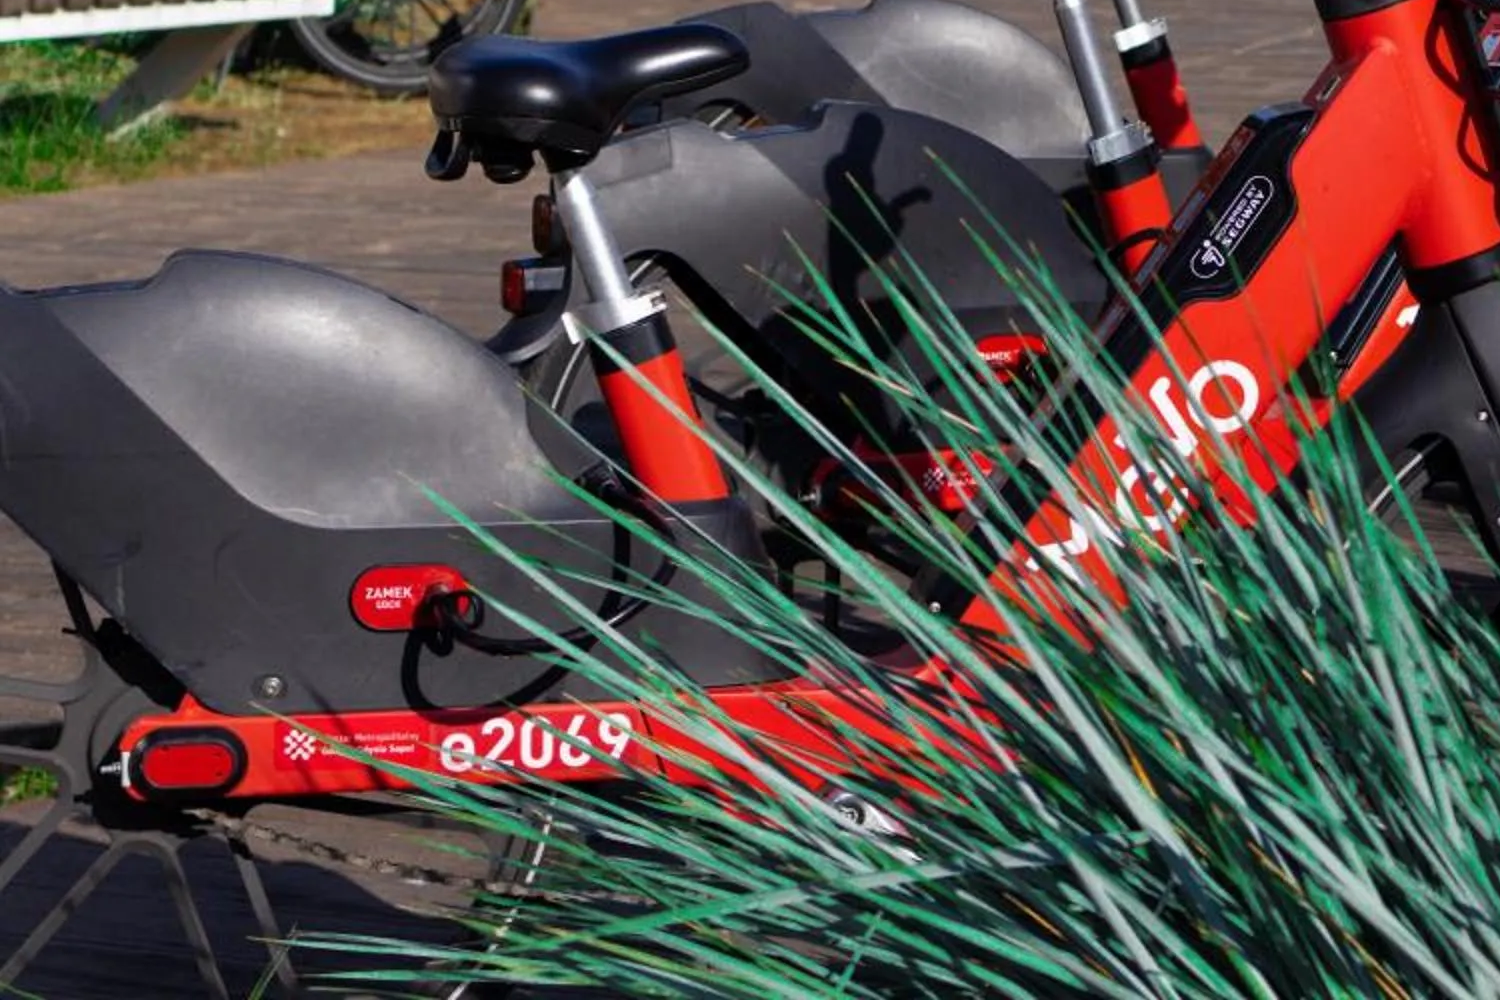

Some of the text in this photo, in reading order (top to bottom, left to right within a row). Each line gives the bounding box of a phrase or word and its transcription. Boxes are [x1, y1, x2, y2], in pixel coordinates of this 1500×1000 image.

[1221, 189, 1265, 249] SEGWAY
[364, 586, 413, 600] ZAMEK
[440, 712, 633, 773] e2069
